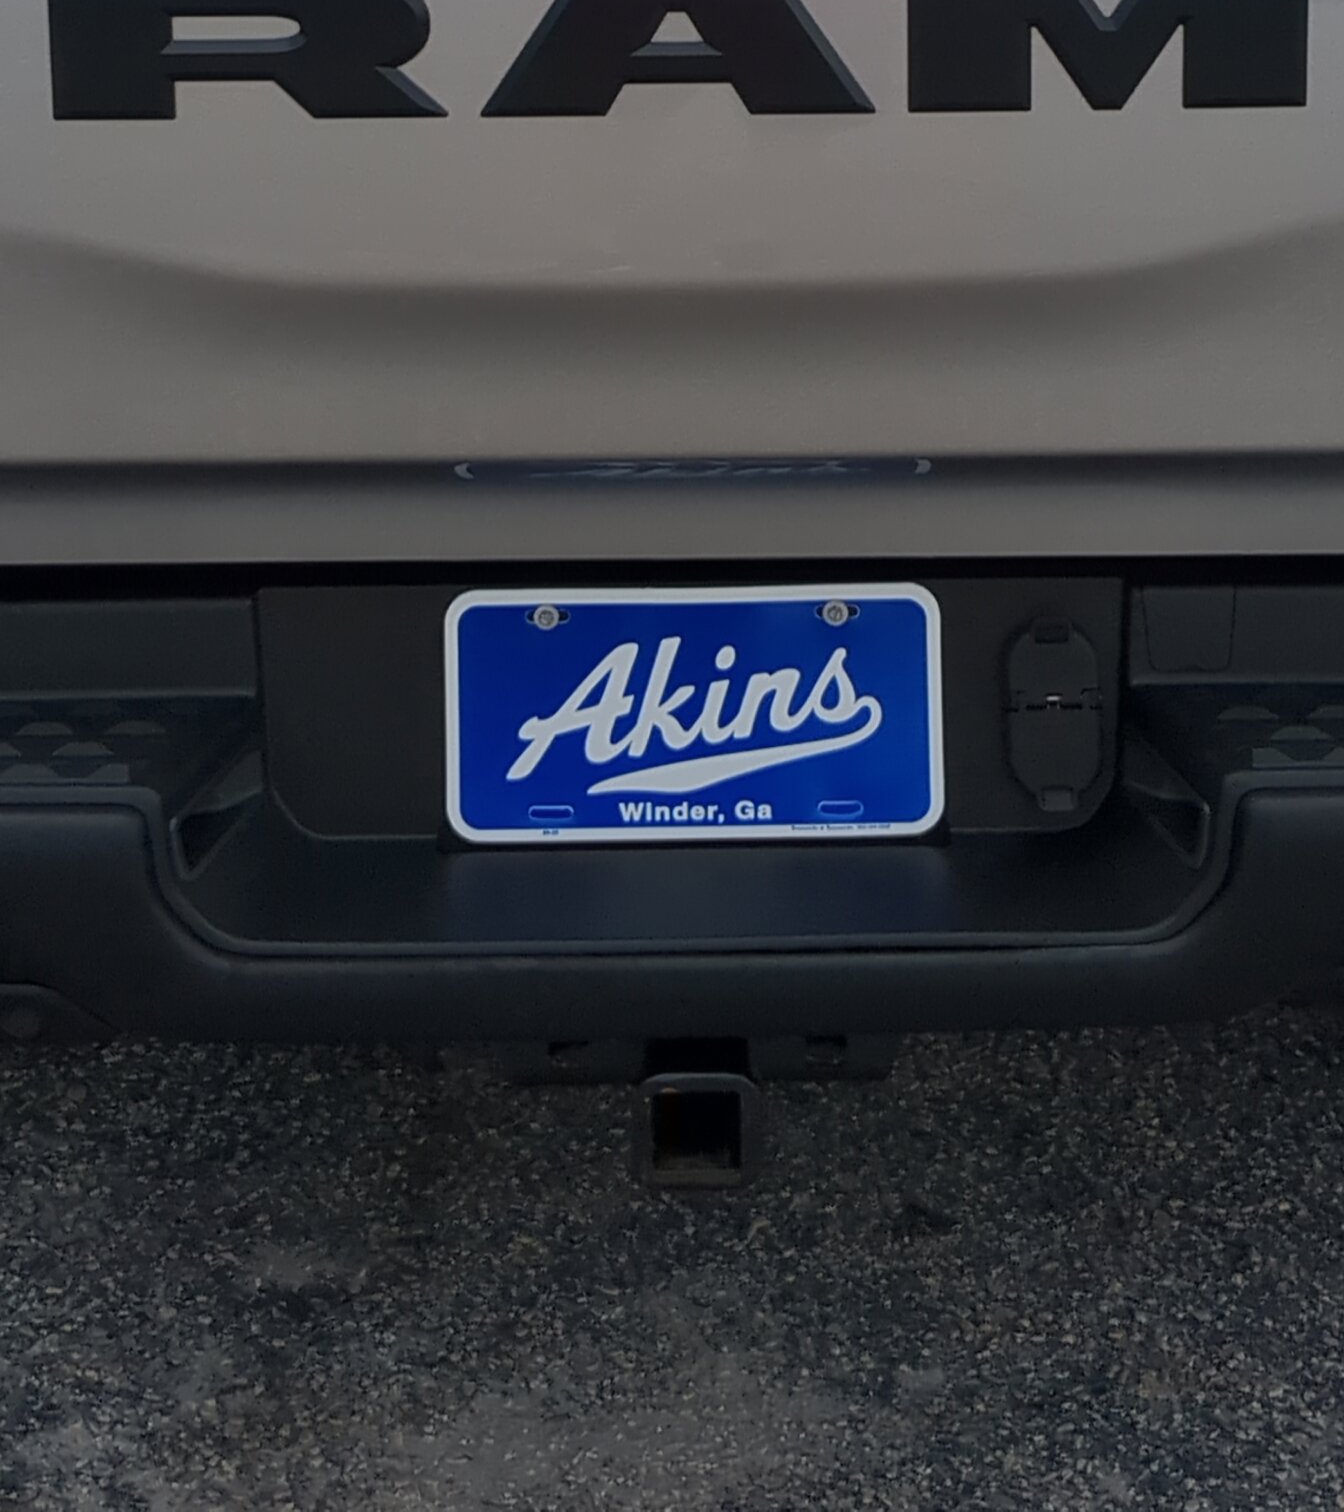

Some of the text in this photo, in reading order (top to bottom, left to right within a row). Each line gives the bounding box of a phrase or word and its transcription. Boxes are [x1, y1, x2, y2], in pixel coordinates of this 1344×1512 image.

[505, 635, 883, 795] Akins
[617, 799, 774, 825] Winder, Ga
